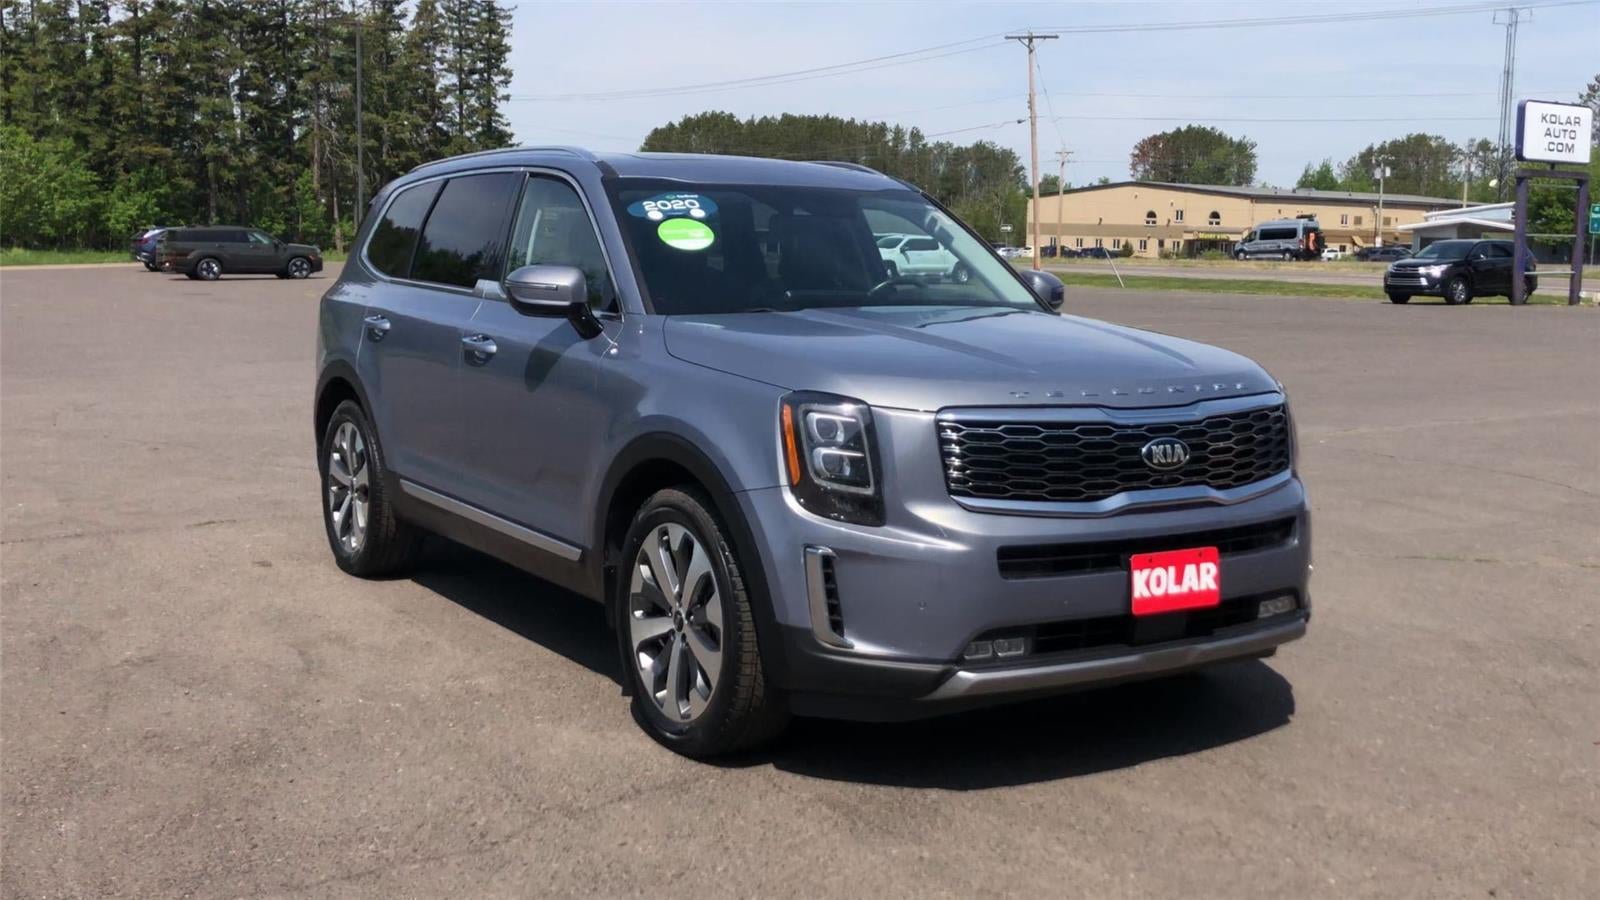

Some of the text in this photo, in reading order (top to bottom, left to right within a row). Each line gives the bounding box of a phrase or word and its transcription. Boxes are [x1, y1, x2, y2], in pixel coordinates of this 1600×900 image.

[1541, 113, 1581, 126] KOLAR
[1544, 127, 1577, 140] AUTO
[1544, 141, 1575, 154] .COM
[642, 199, 700, 211] 2020
[1151, 444, 1185, 464] KIA
[1133, 561, 1218, 599] KOLAR
